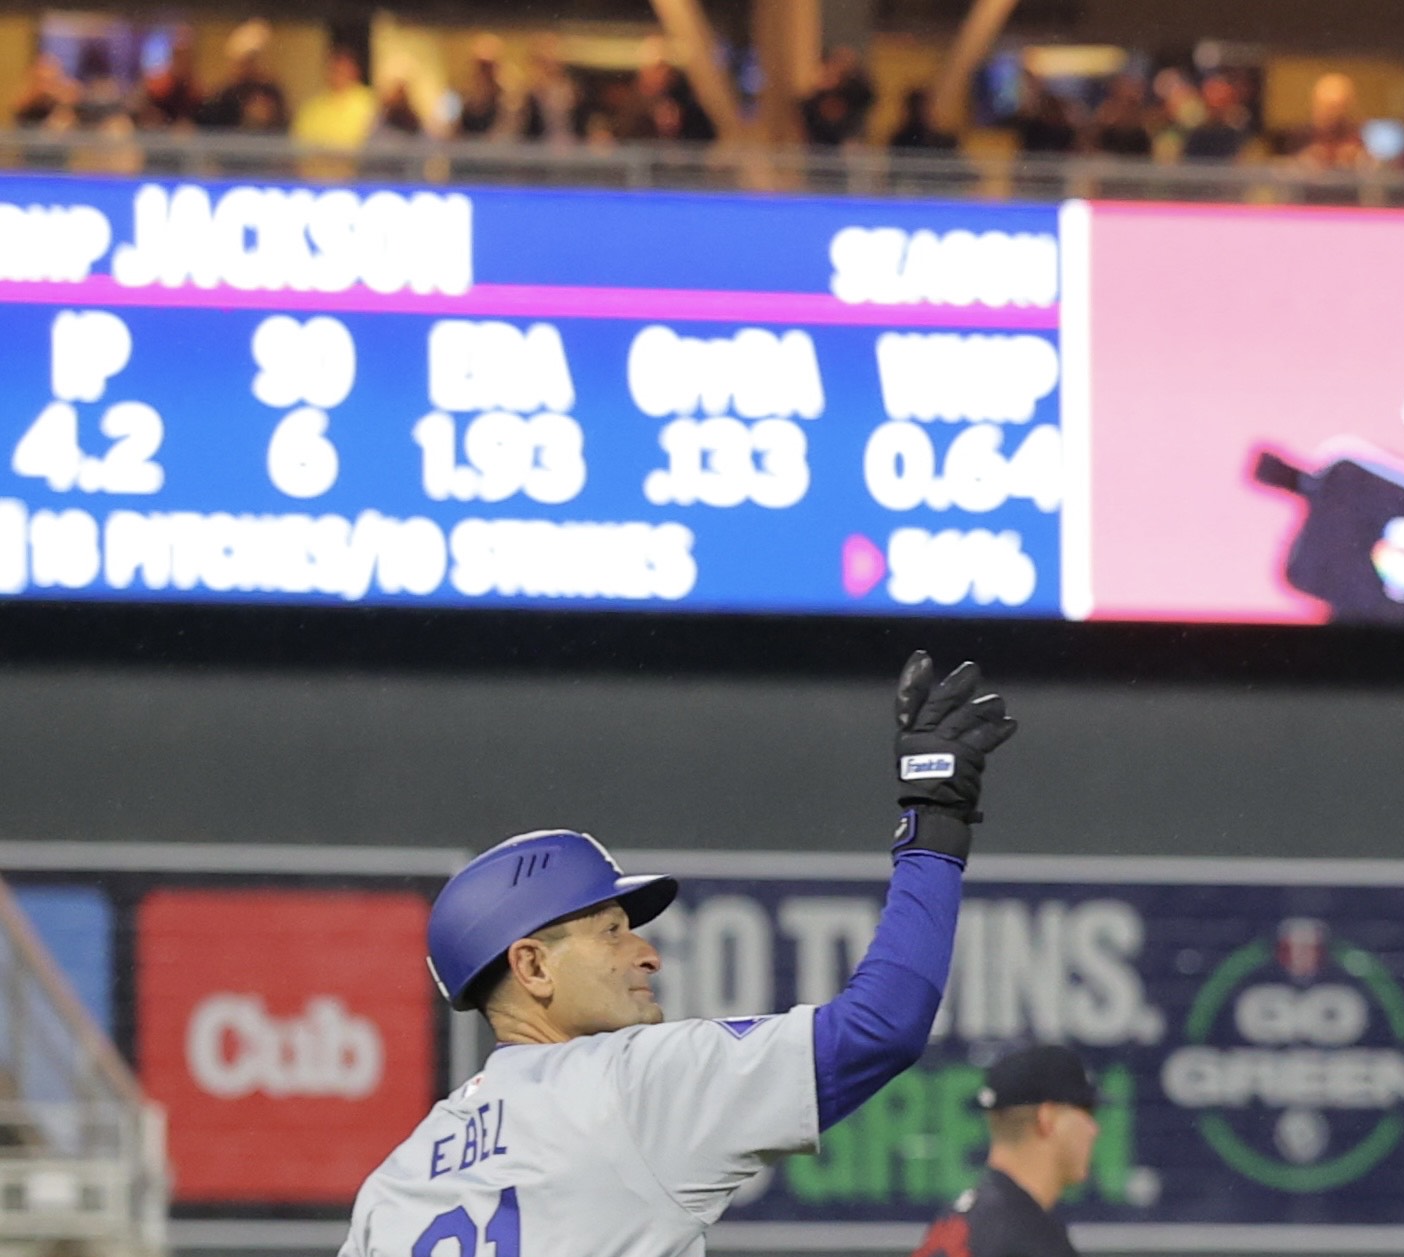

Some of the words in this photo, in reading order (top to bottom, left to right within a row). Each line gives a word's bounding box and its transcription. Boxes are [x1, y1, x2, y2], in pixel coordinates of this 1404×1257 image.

[112, 184, 473, 296] JACKSON
[11, 401, 164, 494] 4.2
[267, 407, 338, 499] 6
[412, 410, 586, 504] 1.93
[643, 417, 810, 509] .133
[863, 419, 1062, 514] 0.64
[778, 893, 1166, 1047] TINS.
[1234, 983, 1369, 1045] GO
[186, 994, 383, 1098] Cub
[430, 1098, 507, 1180] EBEL
